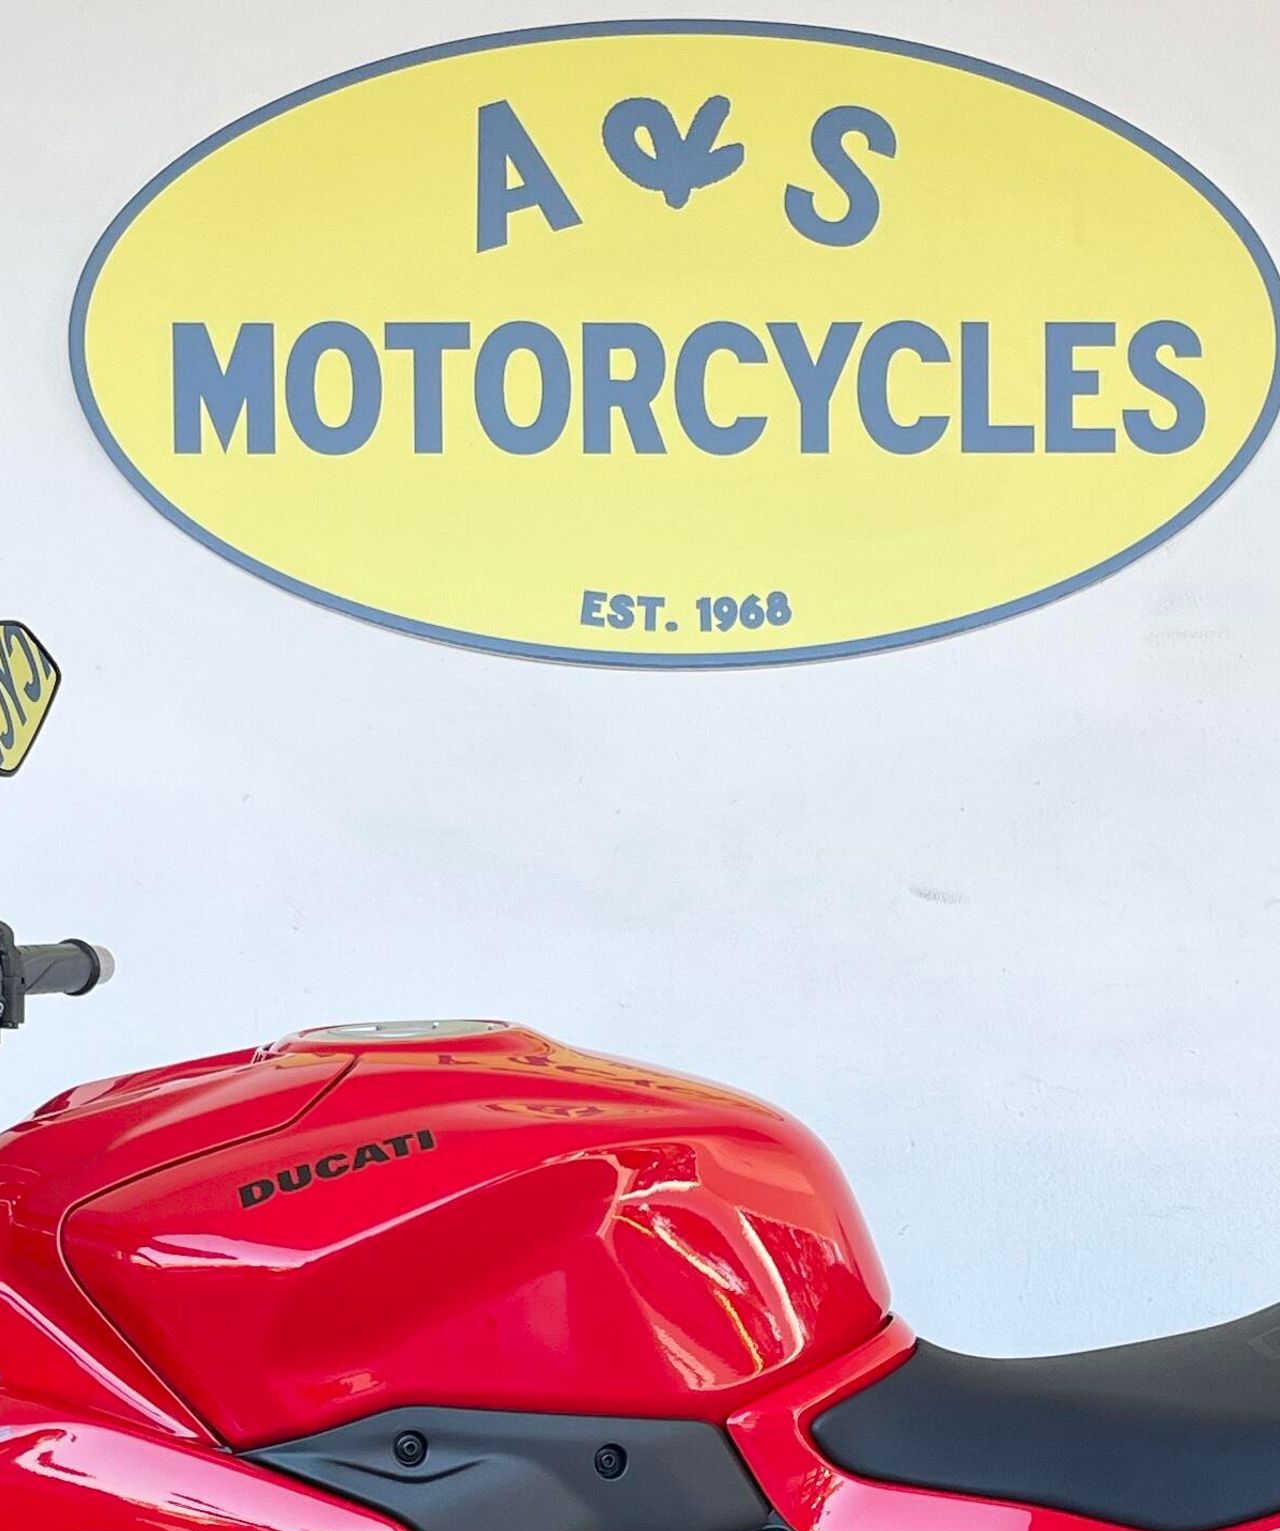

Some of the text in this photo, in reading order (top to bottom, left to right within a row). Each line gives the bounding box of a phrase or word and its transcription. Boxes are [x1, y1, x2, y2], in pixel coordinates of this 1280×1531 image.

[476, 100, 582, 253] A
[784, 106, 897, 246] S
[172, 320, 1206, 456] MOTORCYCLES
[580, 590, 793, 631] EST. 1968
[238, 1129, 436, 1210] DUCATI
